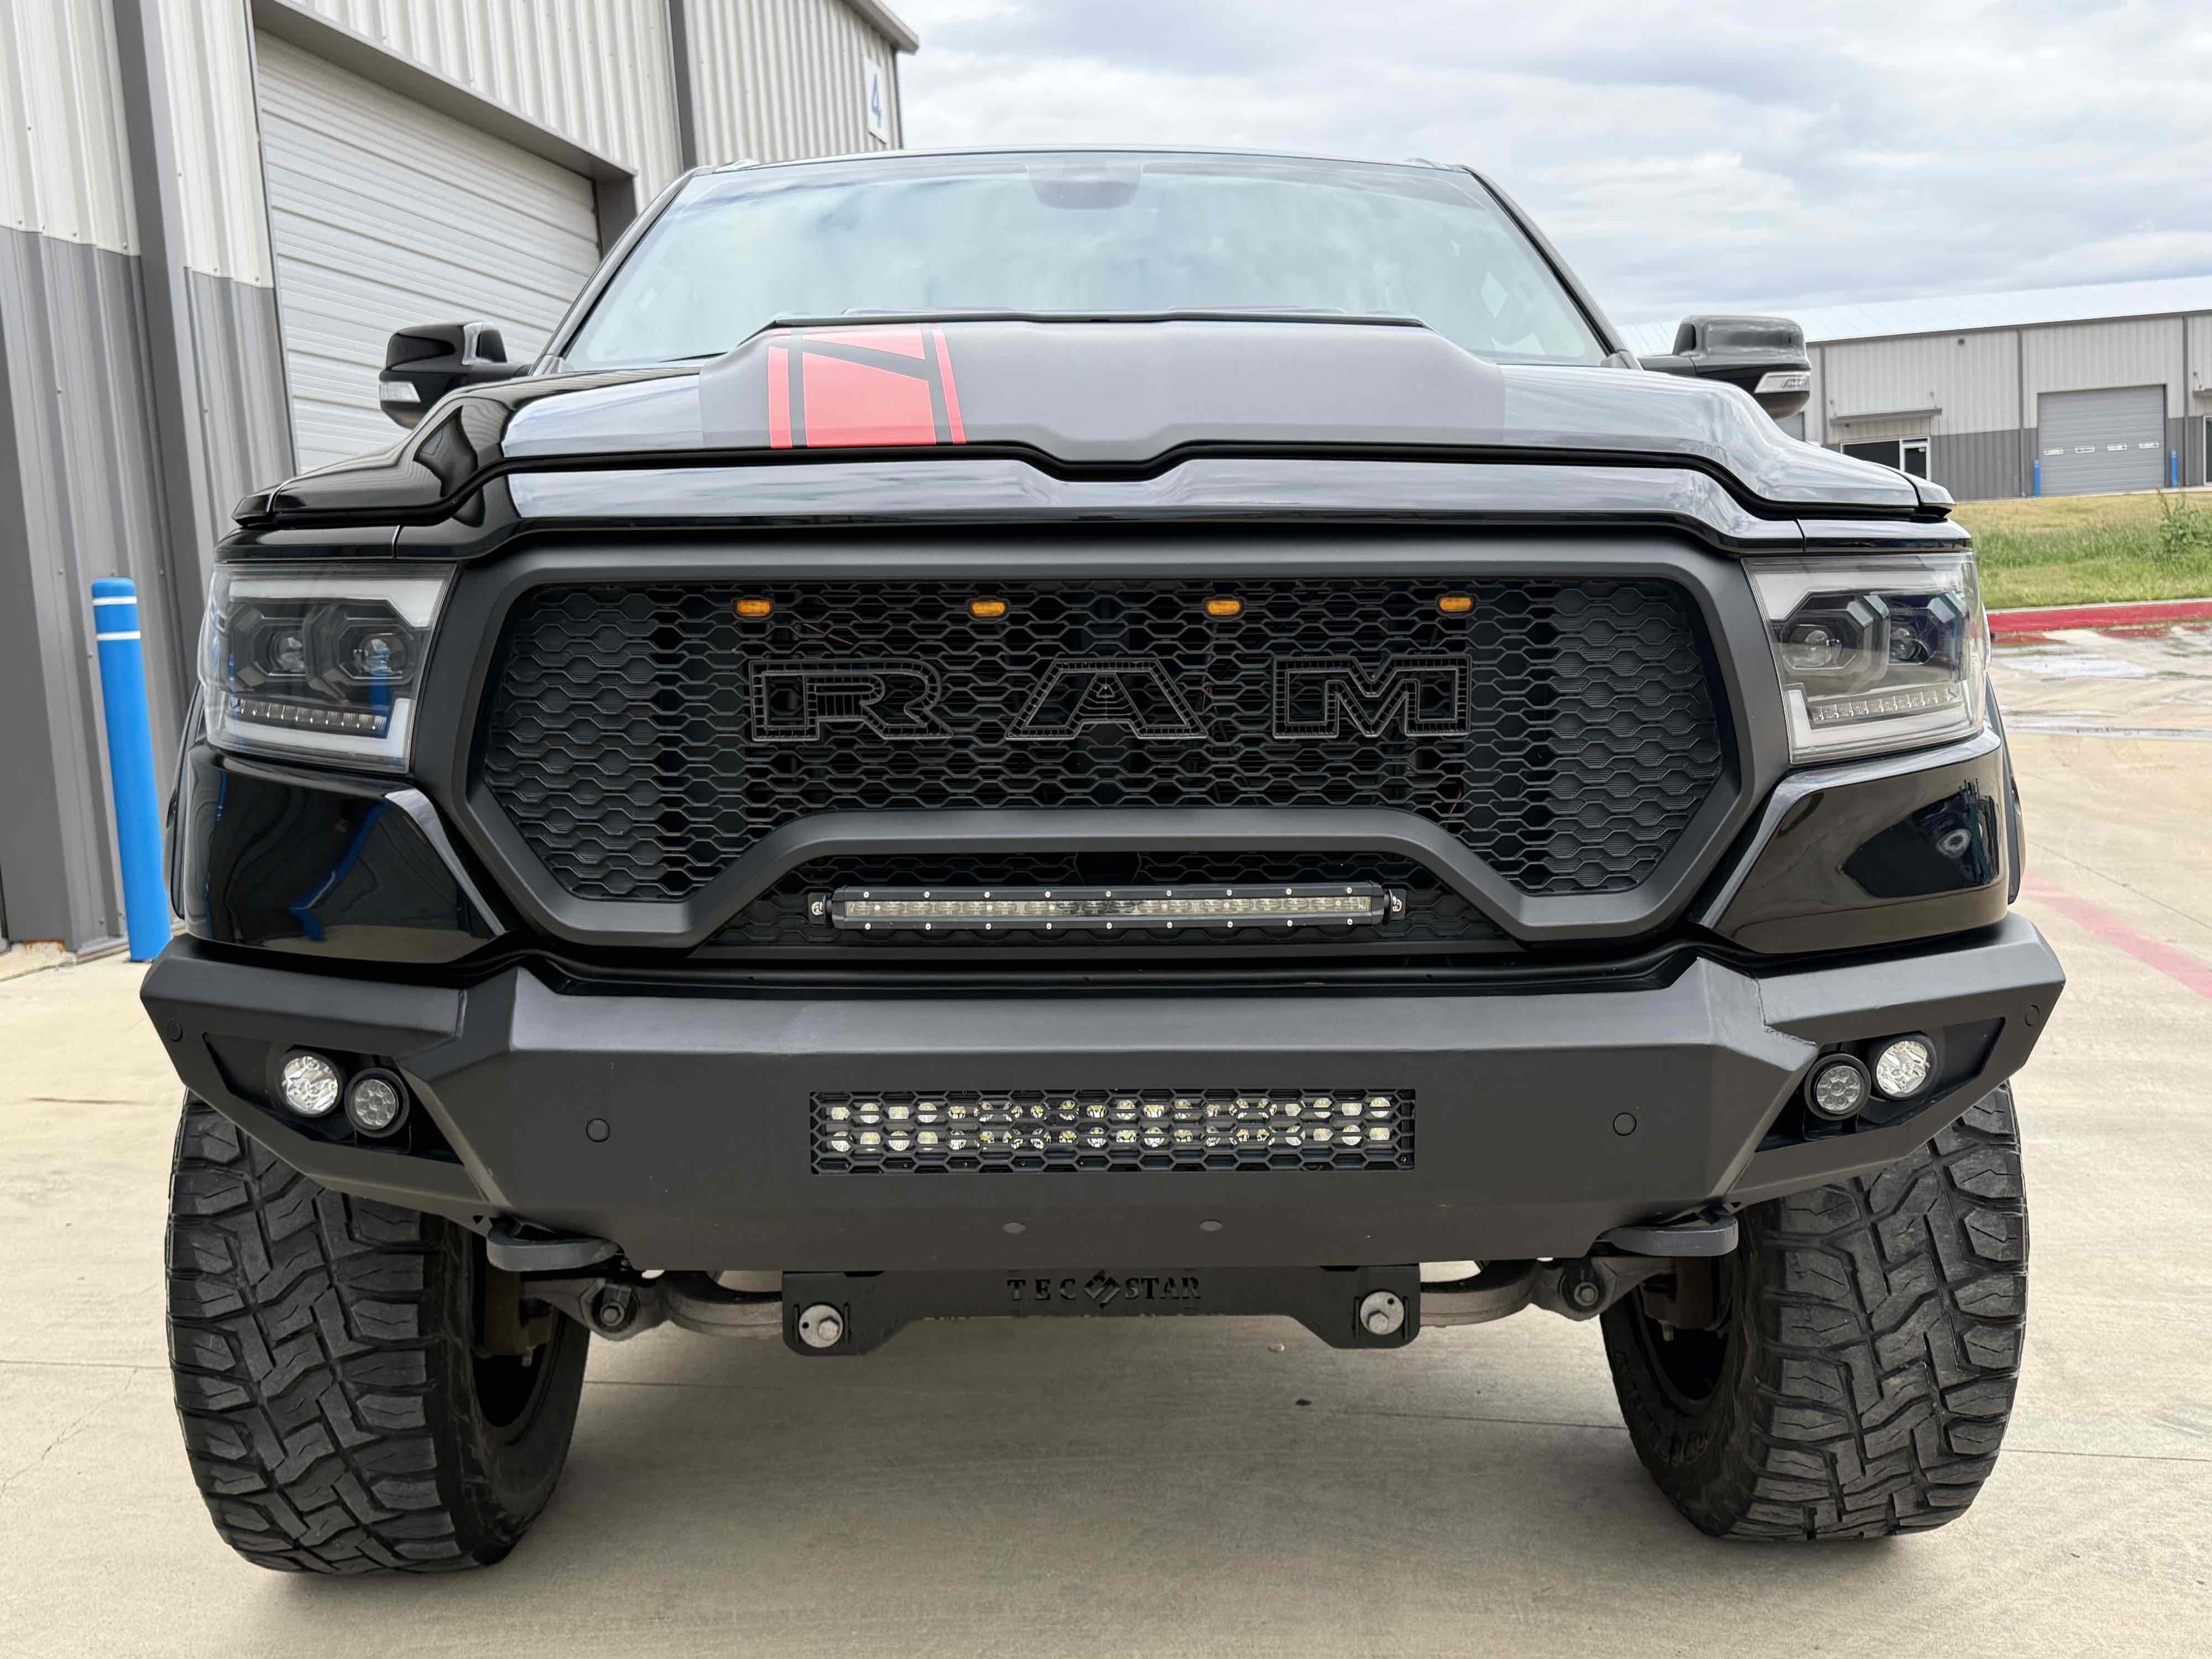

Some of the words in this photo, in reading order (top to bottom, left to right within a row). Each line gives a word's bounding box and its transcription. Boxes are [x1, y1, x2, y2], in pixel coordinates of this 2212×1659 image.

[871, 73, 881, 128] 4
[748, 654, 1473, 741] RAM
[1006, 1279, 1076, 1301] TEC
[1124, 1276, 1202, 1300] STAR
